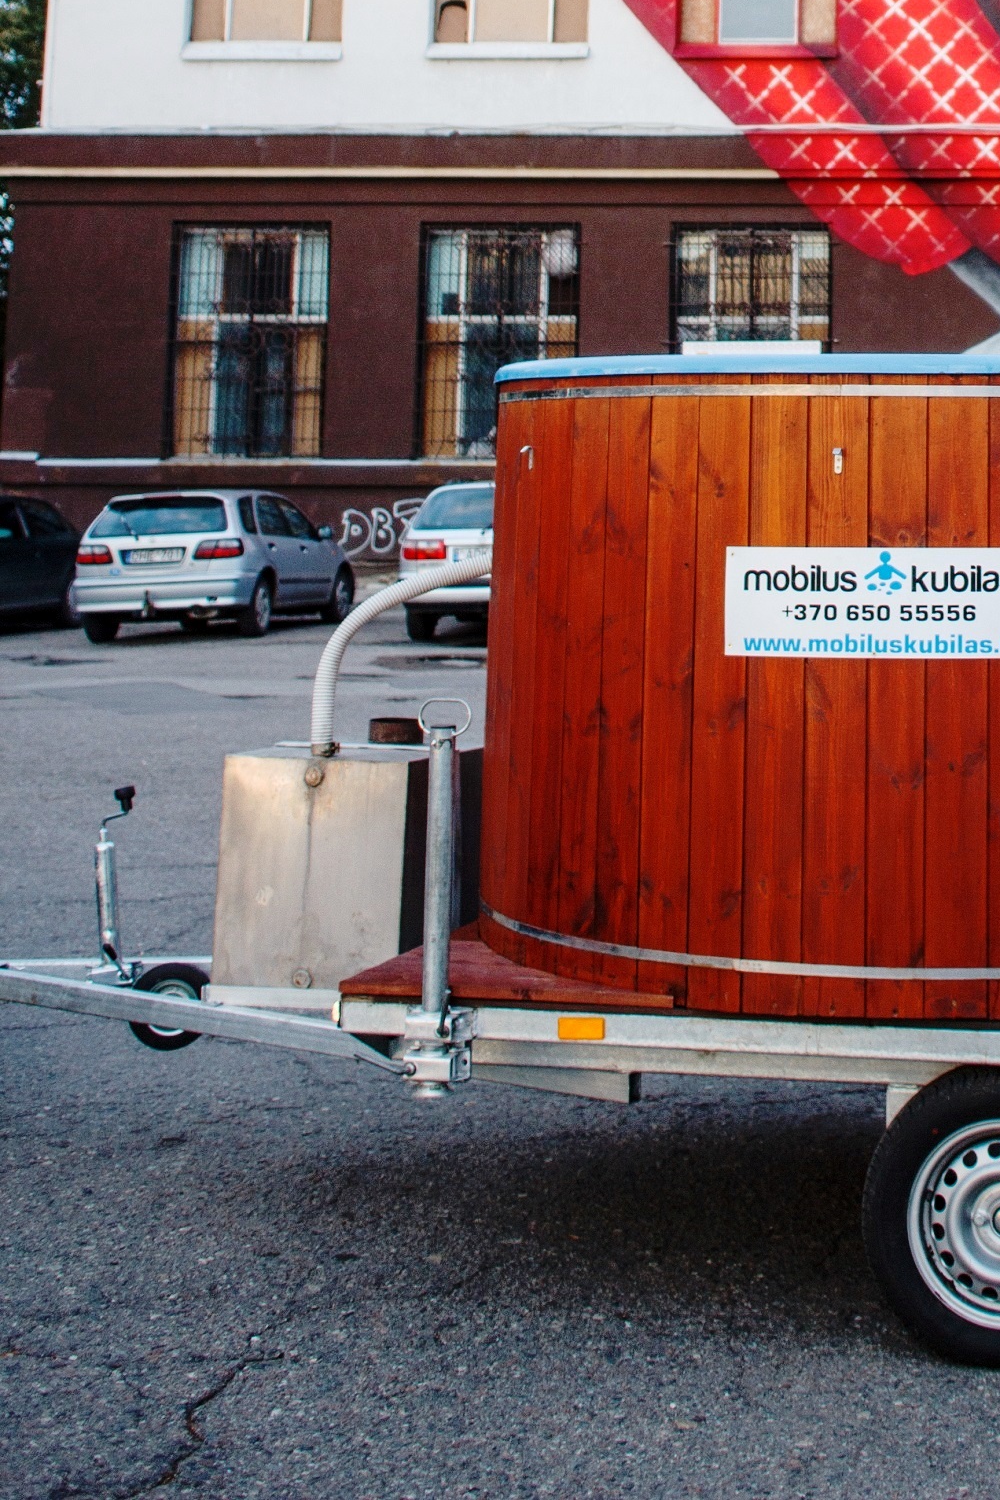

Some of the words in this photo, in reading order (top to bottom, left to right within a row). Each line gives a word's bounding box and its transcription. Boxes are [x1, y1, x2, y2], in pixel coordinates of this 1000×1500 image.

[743, 565, 857, 592] mobilus
[782, 604, 837, 621] +370
[846, 604, 890, 621] 650
[900, 604, 976, 622] 55556
